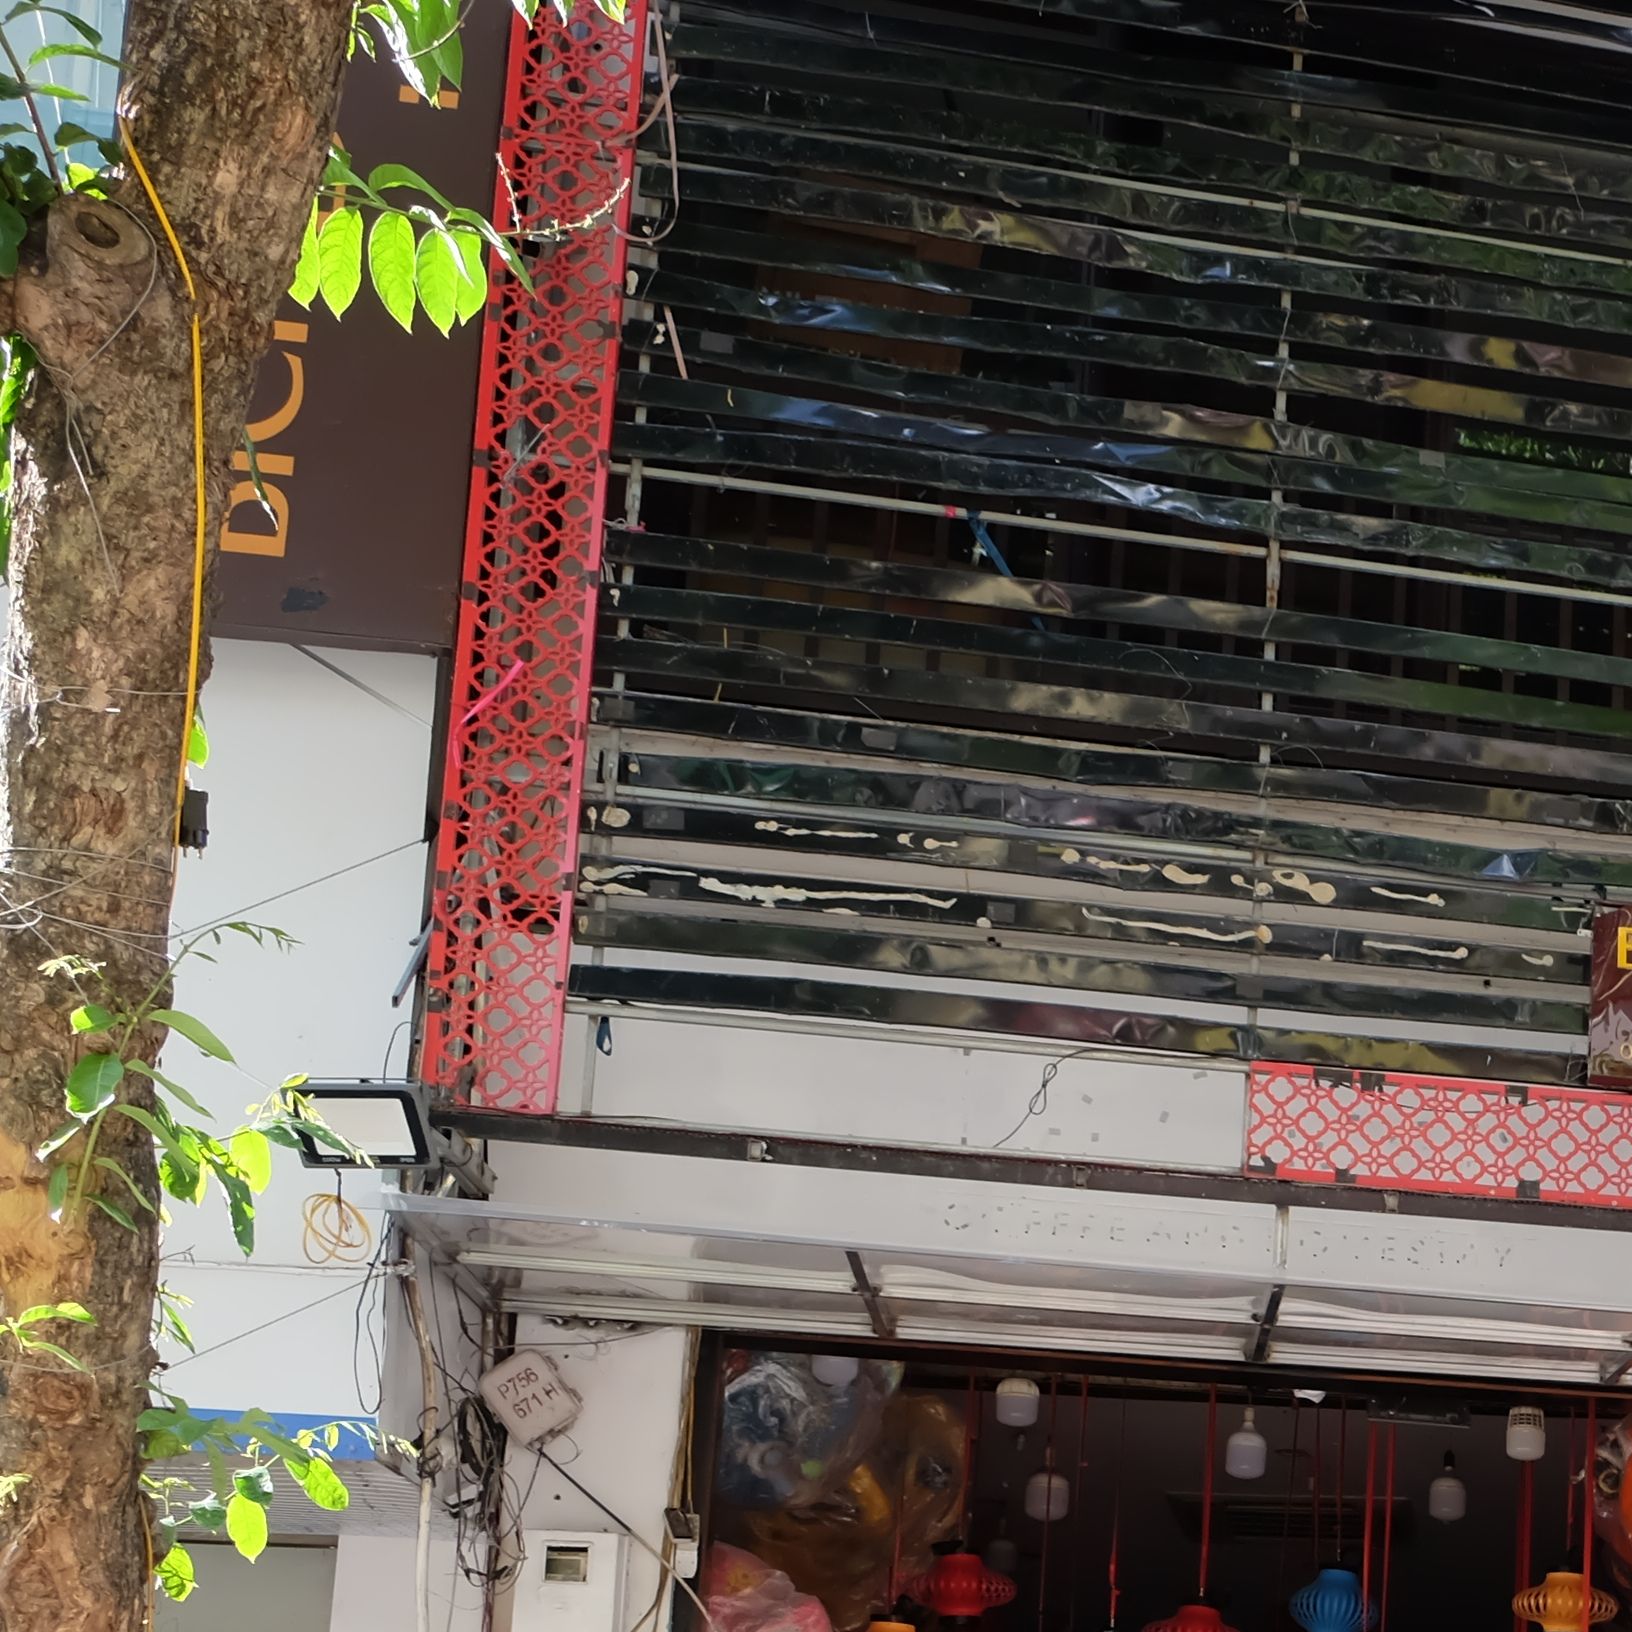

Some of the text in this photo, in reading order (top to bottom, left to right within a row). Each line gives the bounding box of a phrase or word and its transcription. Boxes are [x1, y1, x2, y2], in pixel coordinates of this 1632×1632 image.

[497, 1367, 539, 1400] P756
[512, 1382, 560, 1419] 671 H
